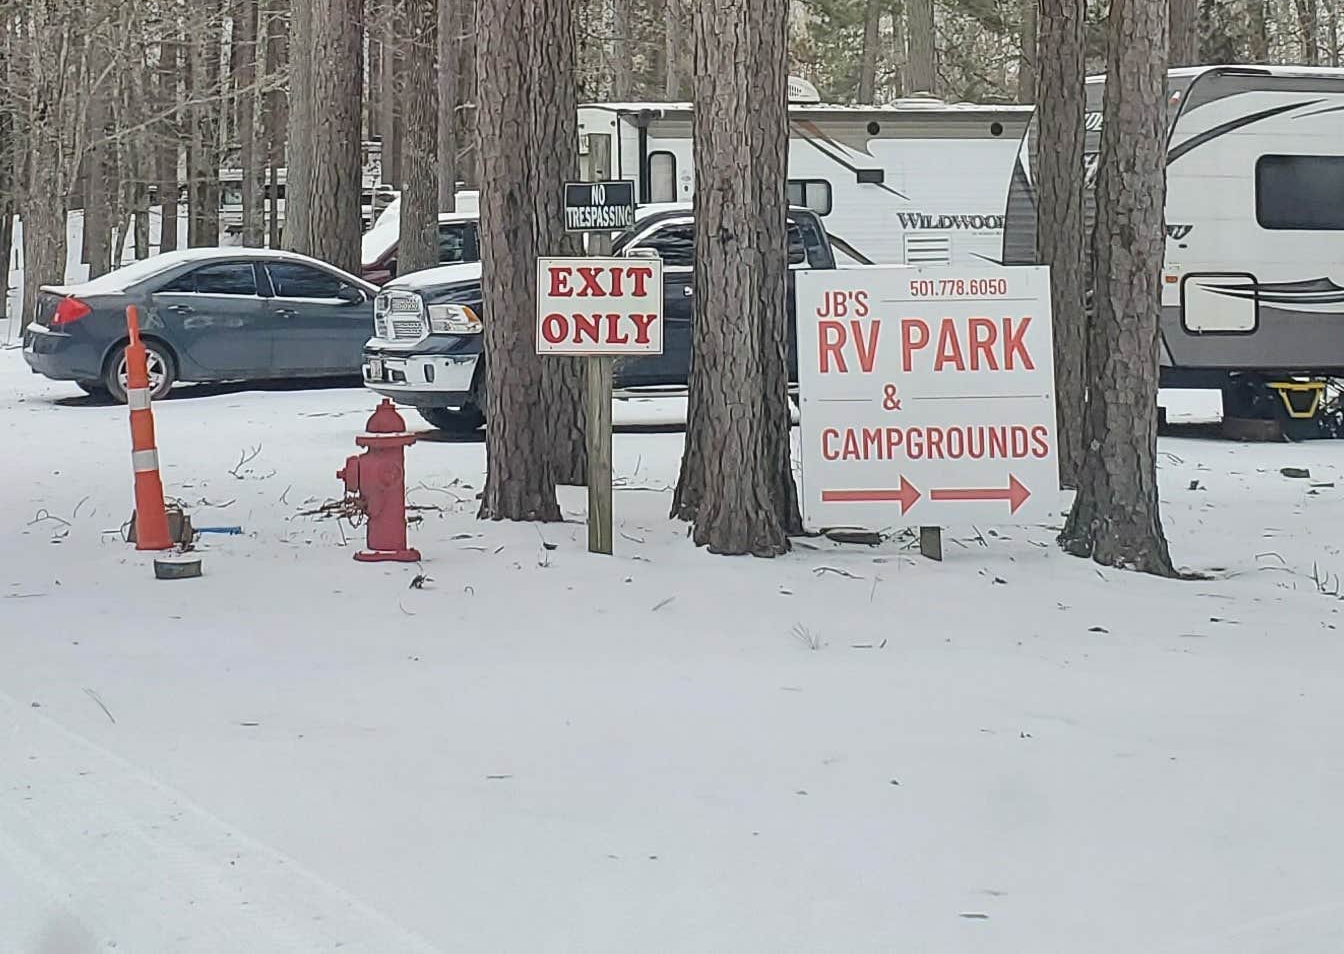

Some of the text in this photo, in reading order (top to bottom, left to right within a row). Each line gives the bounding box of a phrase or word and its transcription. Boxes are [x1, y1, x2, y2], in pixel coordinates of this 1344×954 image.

[591, 184, 606, 205] NO
[566, 205, 632, 227] TRESPASSING
[548, 267, 652, 297] EXIT
[910, 278, 1007, 297] 501.778.6050
[816, 291, 869, 318] JB'S
[541, 313, 657, 343] ONLY
[818, 317, 1035, 373] RV PARK
[882, 384, 902, 411] &
[821, 425, 1050, 461] CAMPGROUNDS
